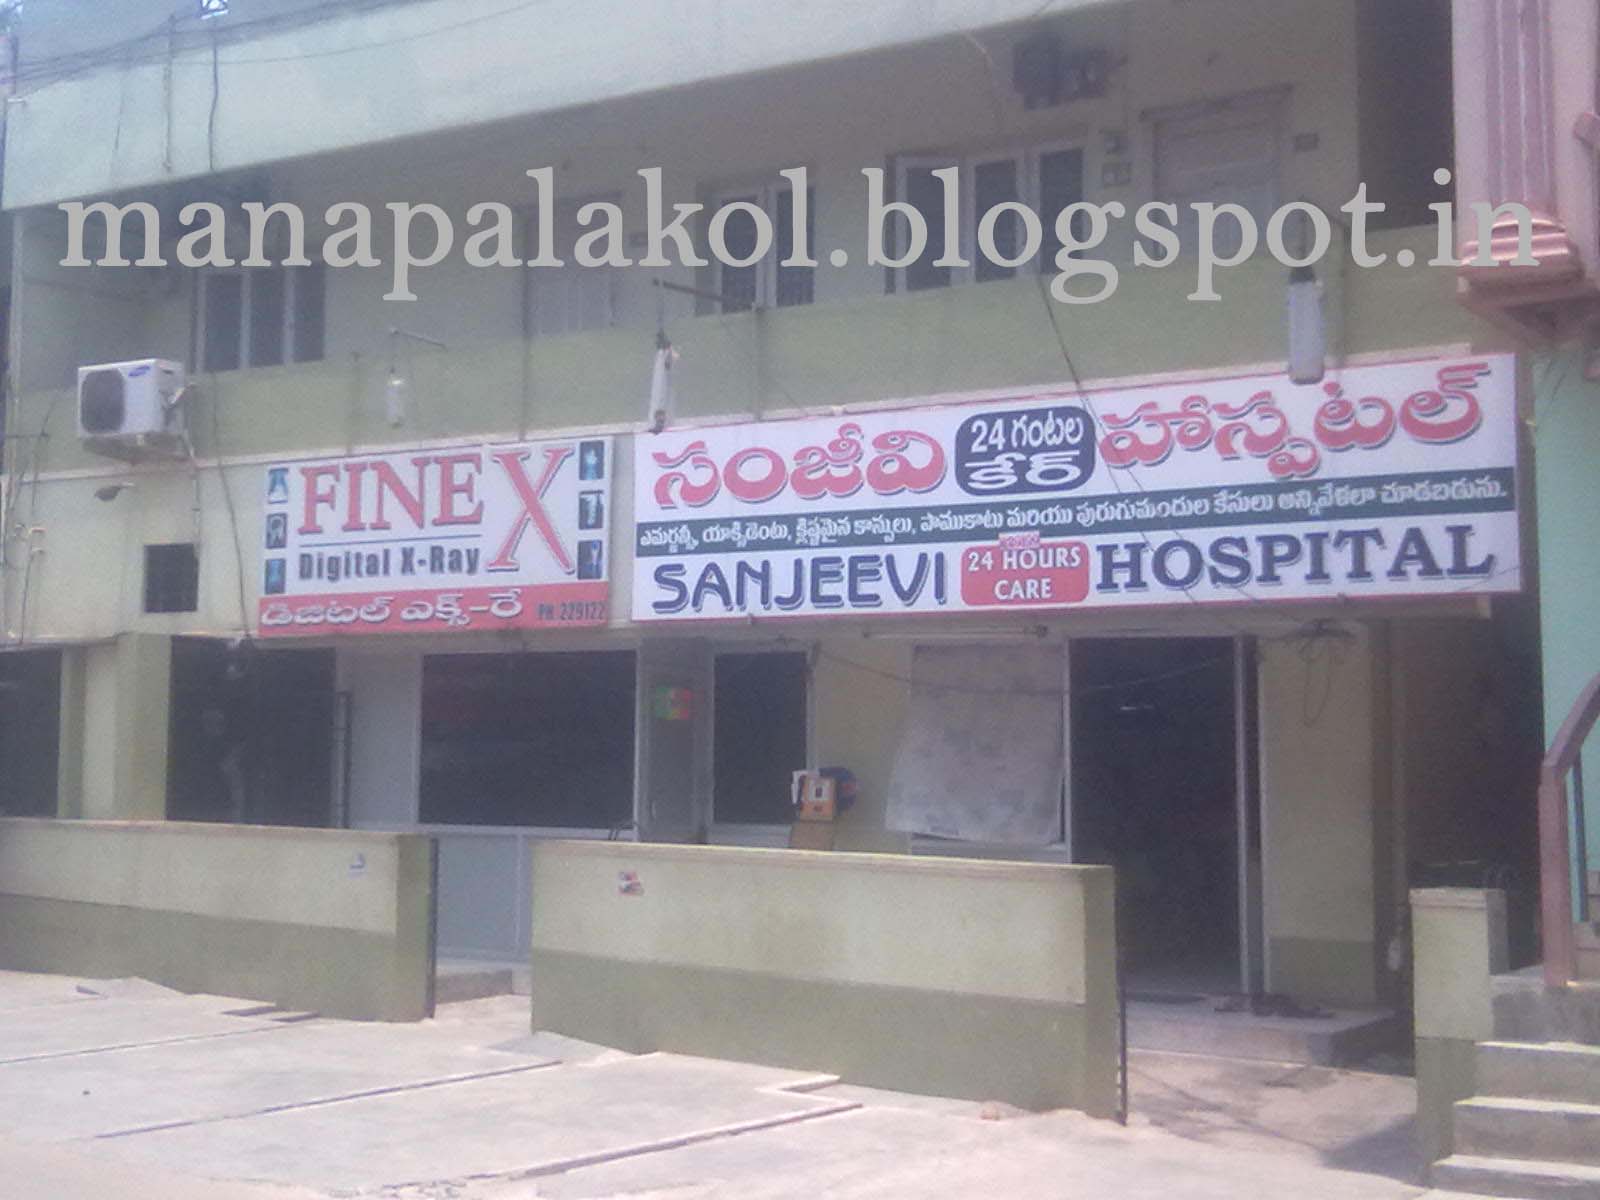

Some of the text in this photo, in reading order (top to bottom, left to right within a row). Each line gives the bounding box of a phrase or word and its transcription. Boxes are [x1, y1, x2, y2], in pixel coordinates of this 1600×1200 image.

[652, 362, 1491, 508] సంజీవి హాస్పటల్
[970, 410, 1084, 453] 24 గంటల
[965, 450, 1081, 490] కేర్
[920, 509, 1003, 532] పాముకాటు
[1006, 504, 1072, 528] మరియు
[1076, 496, 1210, 528] పురుగుమందుల
[1213, 488, 1274, 515] కేసులు
[299, 545, 480, 582] Digital X-Ray
[652, 524, 1497, 613] SANJEEVI HOSPITAL
[968, 546, 1082, 571] 24 HOURS
[994, 578, 1053, 600] CARE
